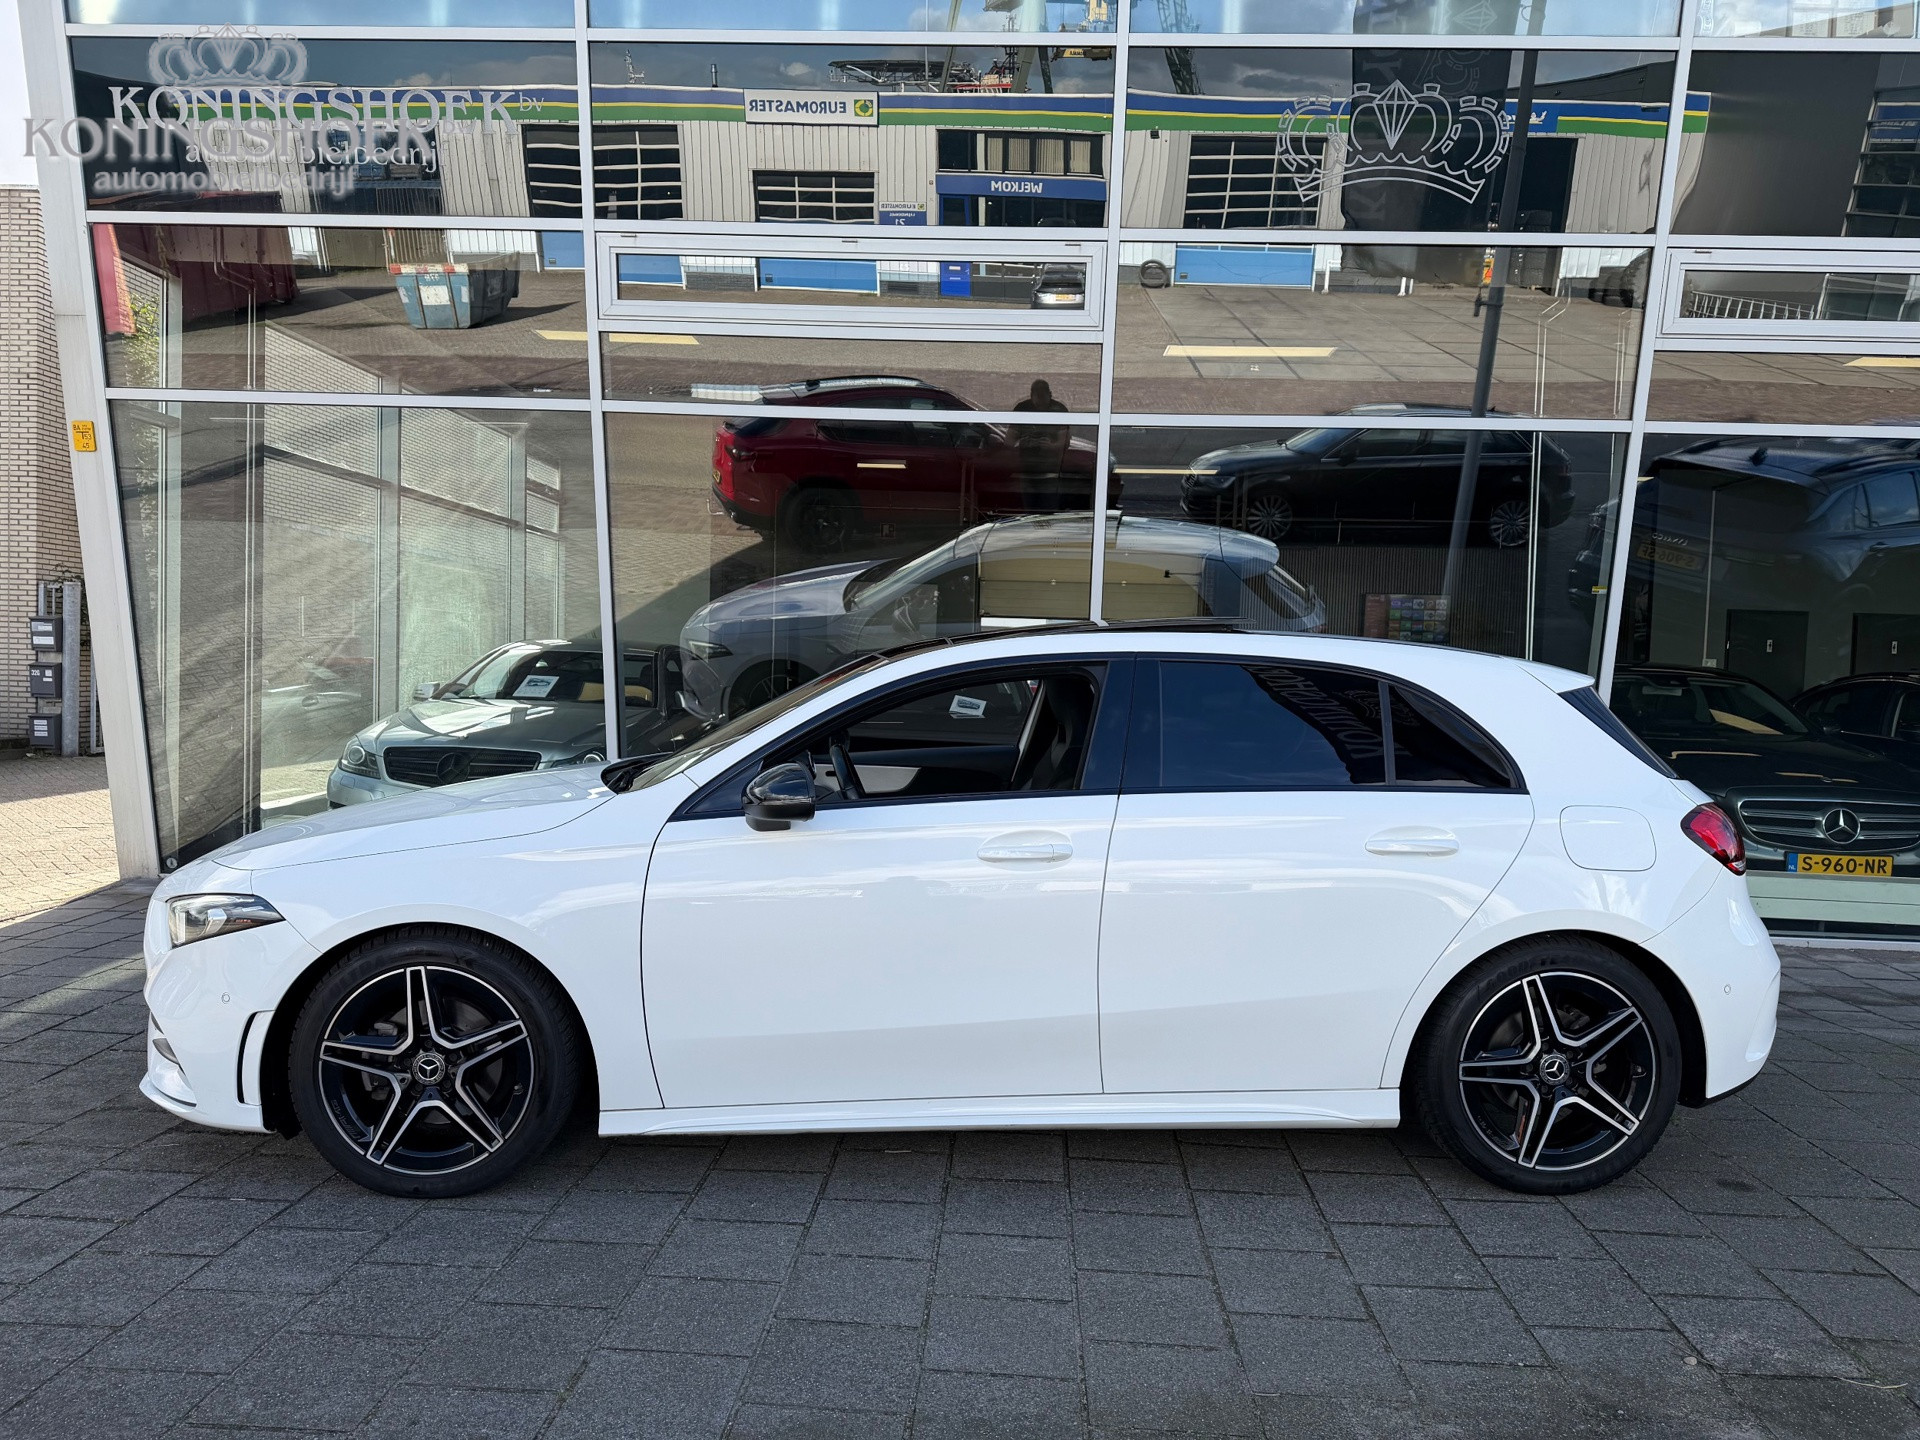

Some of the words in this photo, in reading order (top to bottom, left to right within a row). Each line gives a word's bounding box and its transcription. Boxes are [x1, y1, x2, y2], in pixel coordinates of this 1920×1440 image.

[108, 85, 519, 135] KONINGSHOEK
[519, 91, 545, 112] bv
[1801, 856, 1888, 874] S-960-NR
